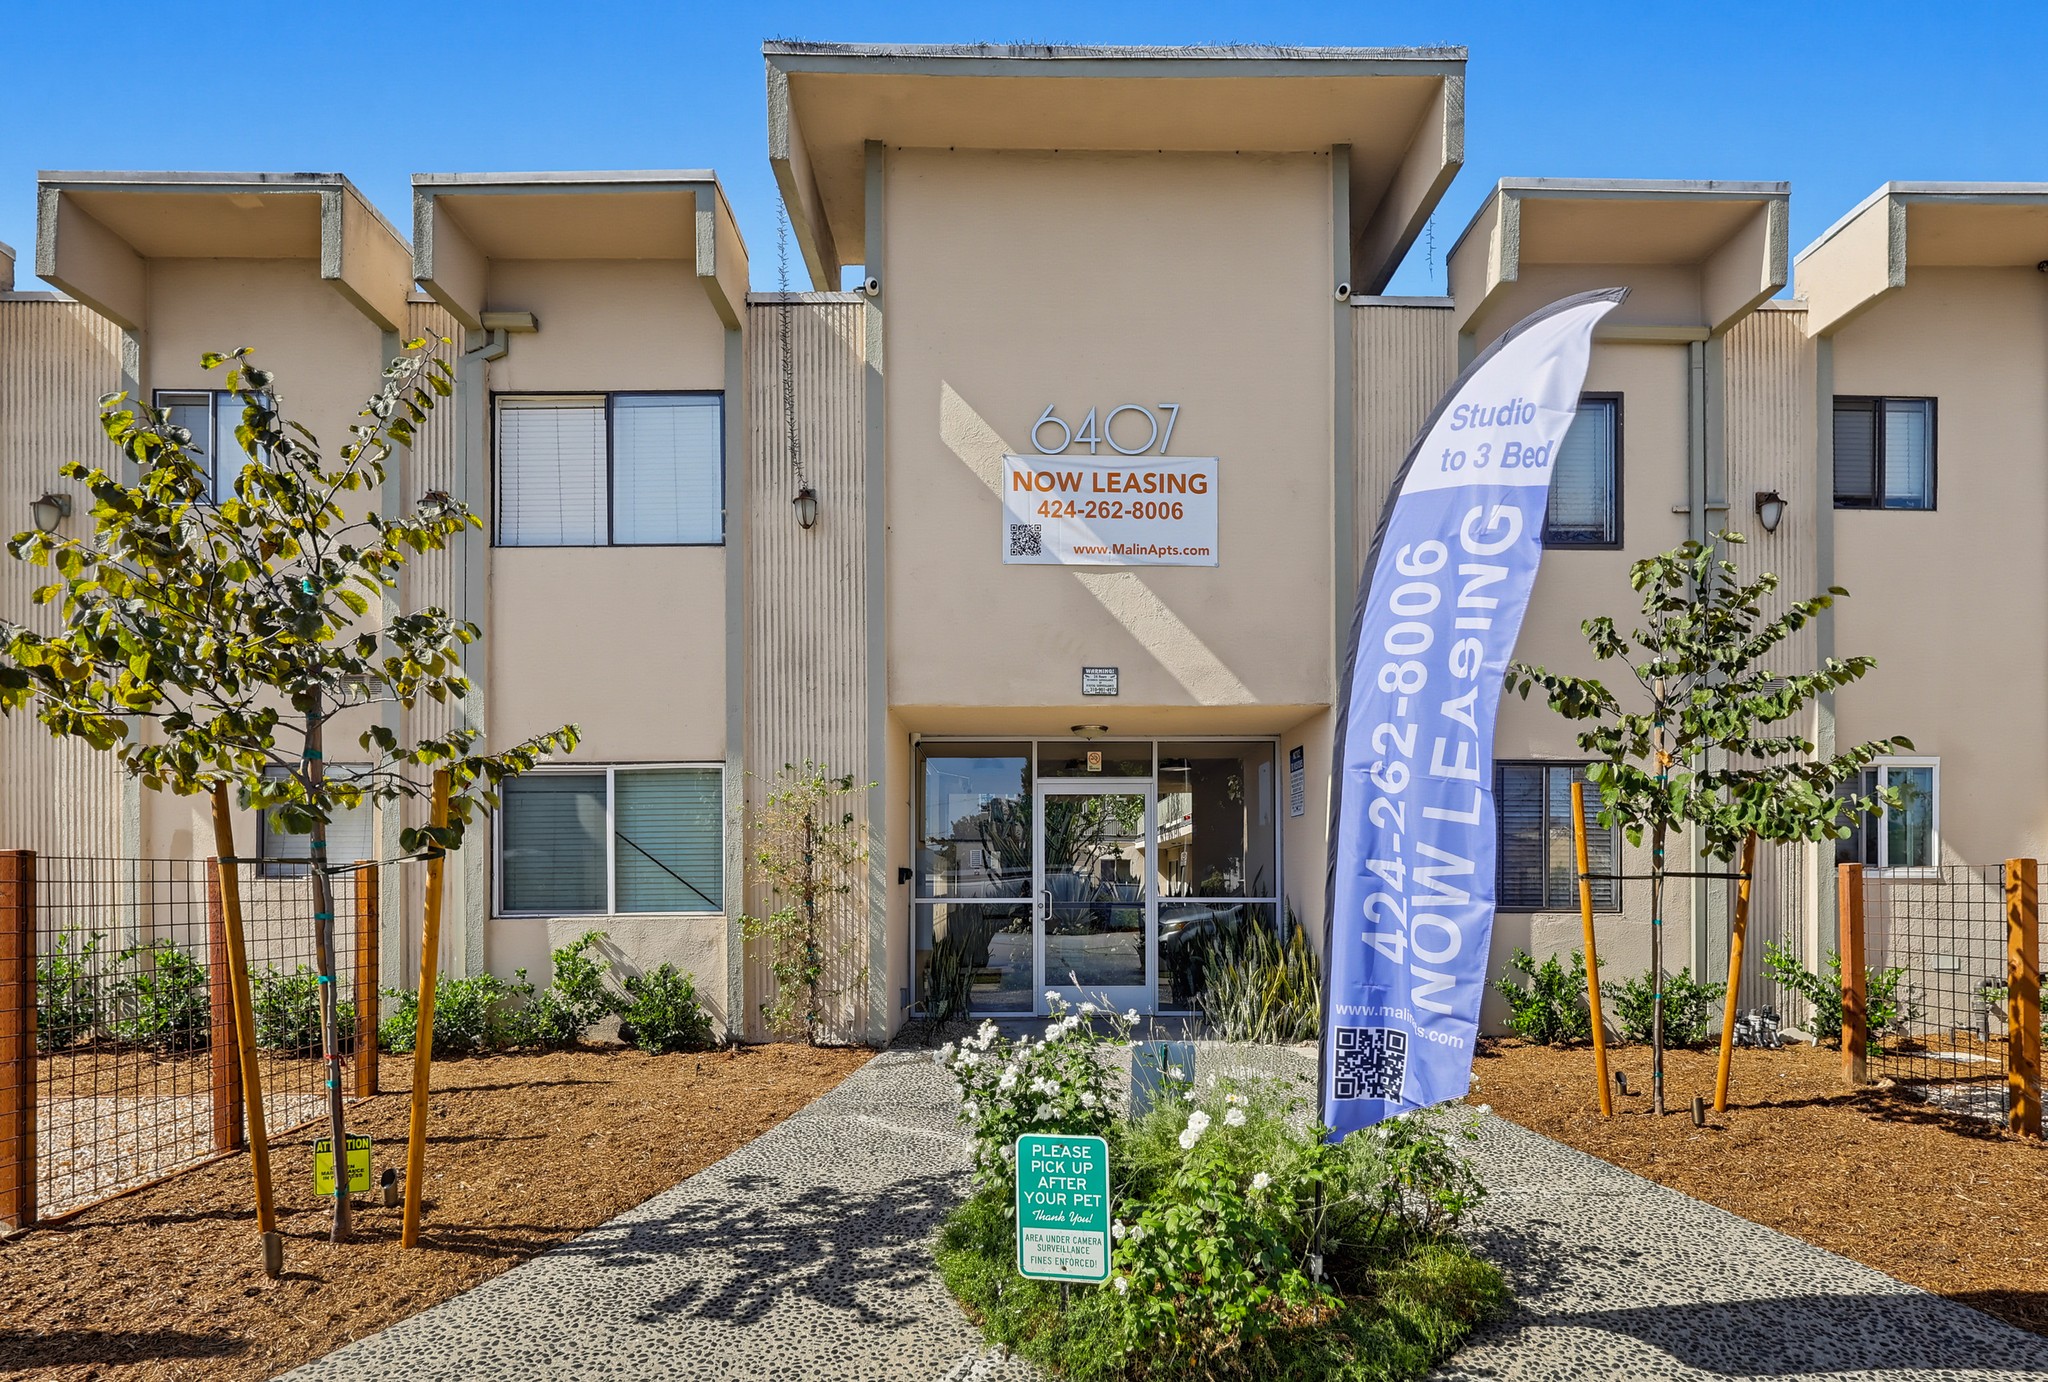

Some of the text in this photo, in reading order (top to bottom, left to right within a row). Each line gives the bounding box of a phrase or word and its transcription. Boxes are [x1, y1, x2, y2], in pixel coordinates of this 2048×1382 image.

[1450, 398, 1536, 431] Studio
[1031, 403, 1180, 455] 6407
[1441, 440, 1554, 472] to 3 Bed
[1013, 471, 1208, 495] NOW LEASING
[1037, 499, 1184, 520] 424-262-8006
[1073, 543, 1210, 558] www.MalinApts.com
[1361, 539, 1449, 965] 424-262-8006
[1410, 504, 1523, 1016] NOW LEASING
[317, 1138, 369, 1152] ATTTION
[1032, 1144, 1092, 1159] PLEASE
[1031, 1160, 1094, 1175] PICK UP
[1037, 1176, 1087, 1191] AFTER
[1024, 1191, 1102, 1207] YOUR PET
[1032, 1210, 1094, 1226] Thank You!
[1025, 1234, 1102, 1246] AREA UNDER CAMERA
[1036, 1244, 1090, 1255] SURVEILLANCE
[1030, 1255, 1097, 1269] FINES ENFORCED!
